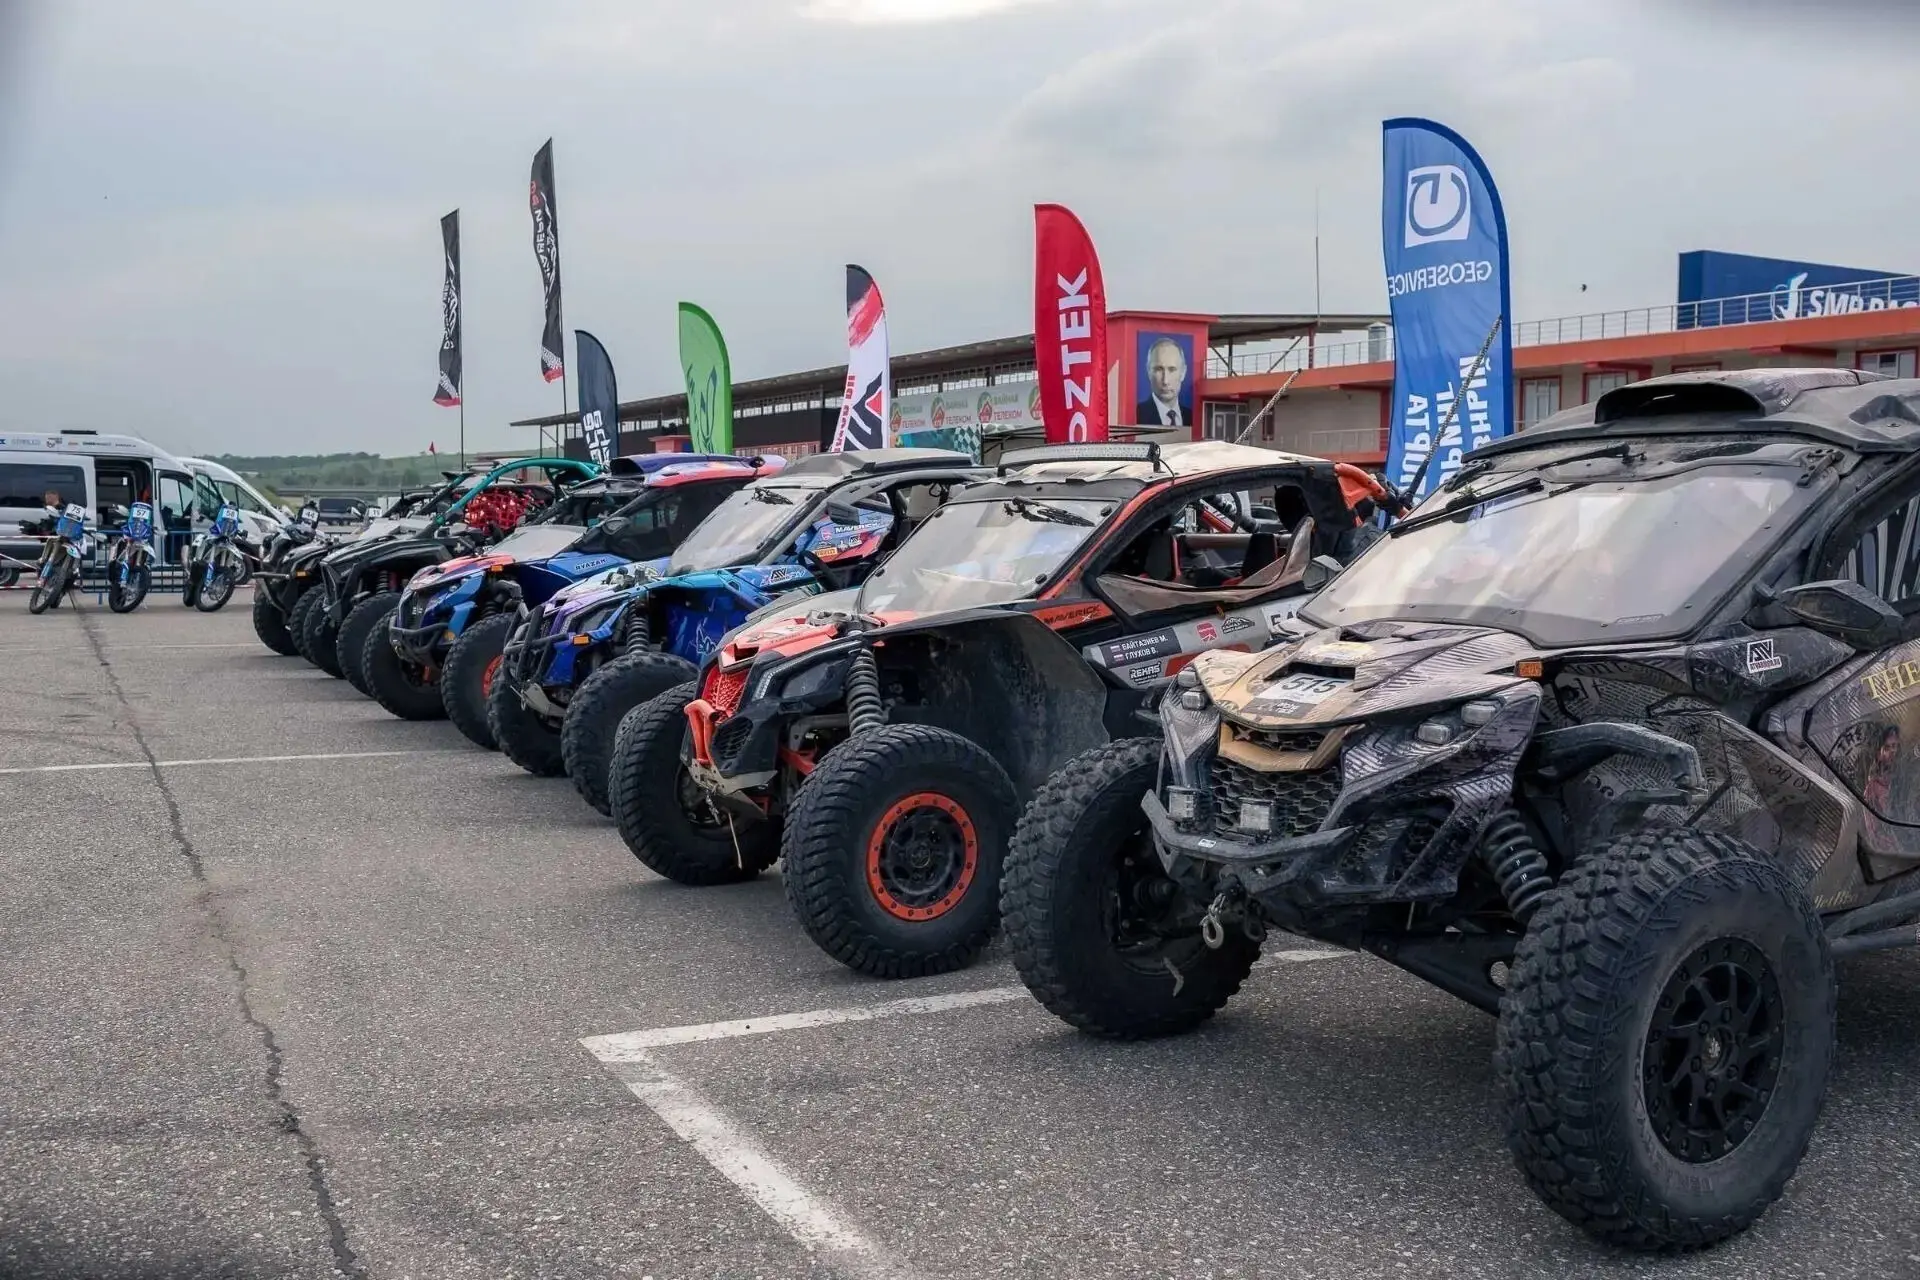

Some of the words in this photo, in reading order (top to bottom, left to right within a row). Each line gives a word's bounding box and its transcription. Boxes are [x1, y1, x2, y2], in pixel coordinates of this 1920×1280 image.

[1044, 605, 1100, 624] MAVERICK
[1125, 650, 1150, 660] ГЛУХОВ
[1281, 677, 1345, 694] 515
[1861, 659, 1920, 700] THE
